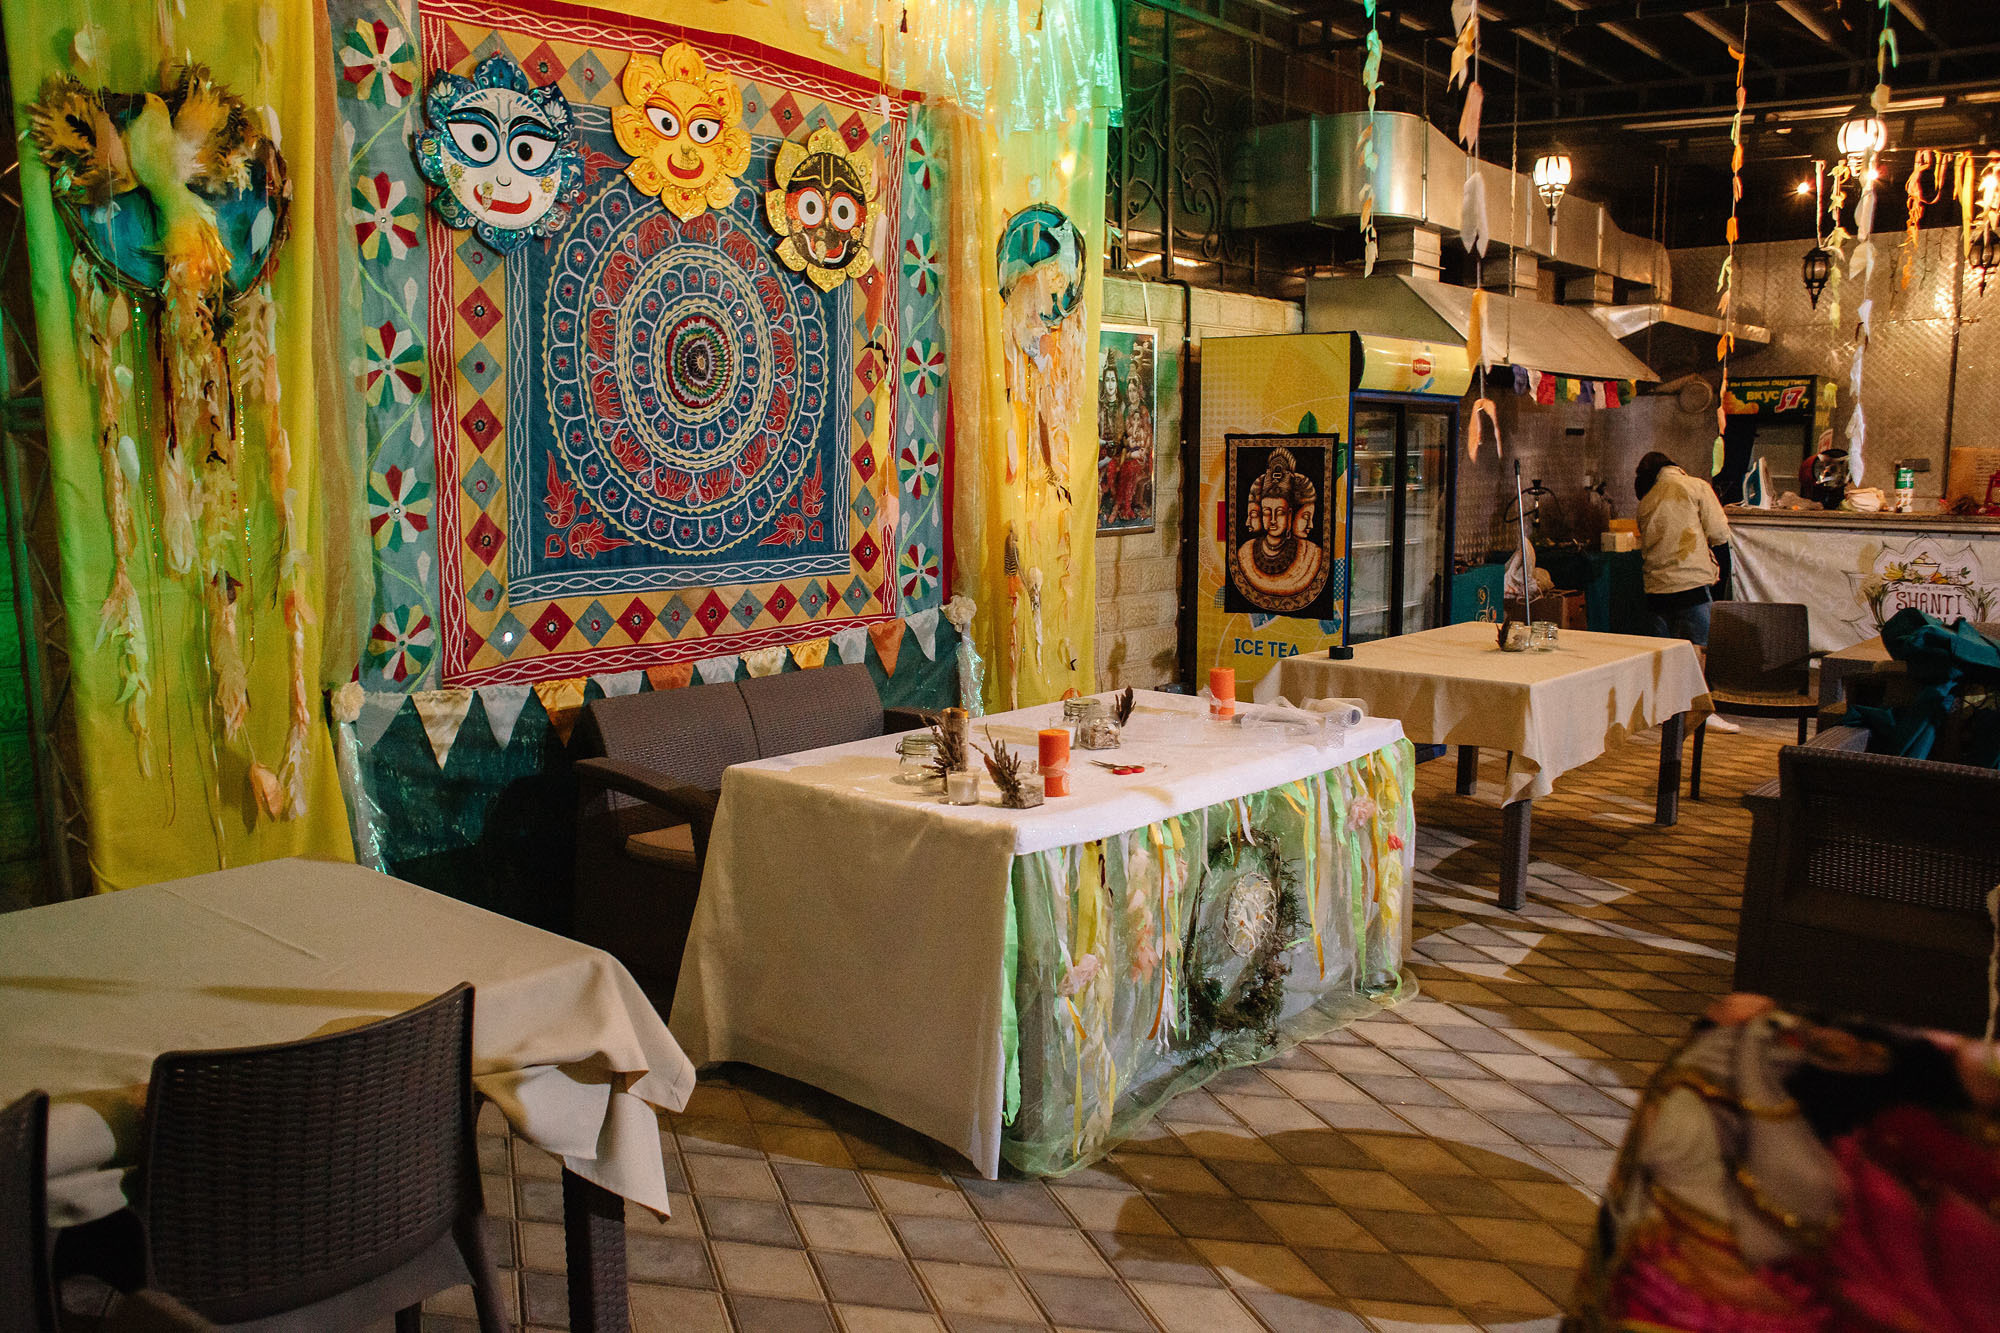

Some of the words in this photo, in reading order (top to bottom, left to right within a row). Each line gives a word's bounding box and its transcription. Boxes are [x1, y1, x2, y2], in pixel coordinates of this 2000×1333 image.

[1895, 591, 1962, 615] SHANTI
[1233, 638, 1264, 656] ICE
[1267, 641, 1300, 658] TEA
